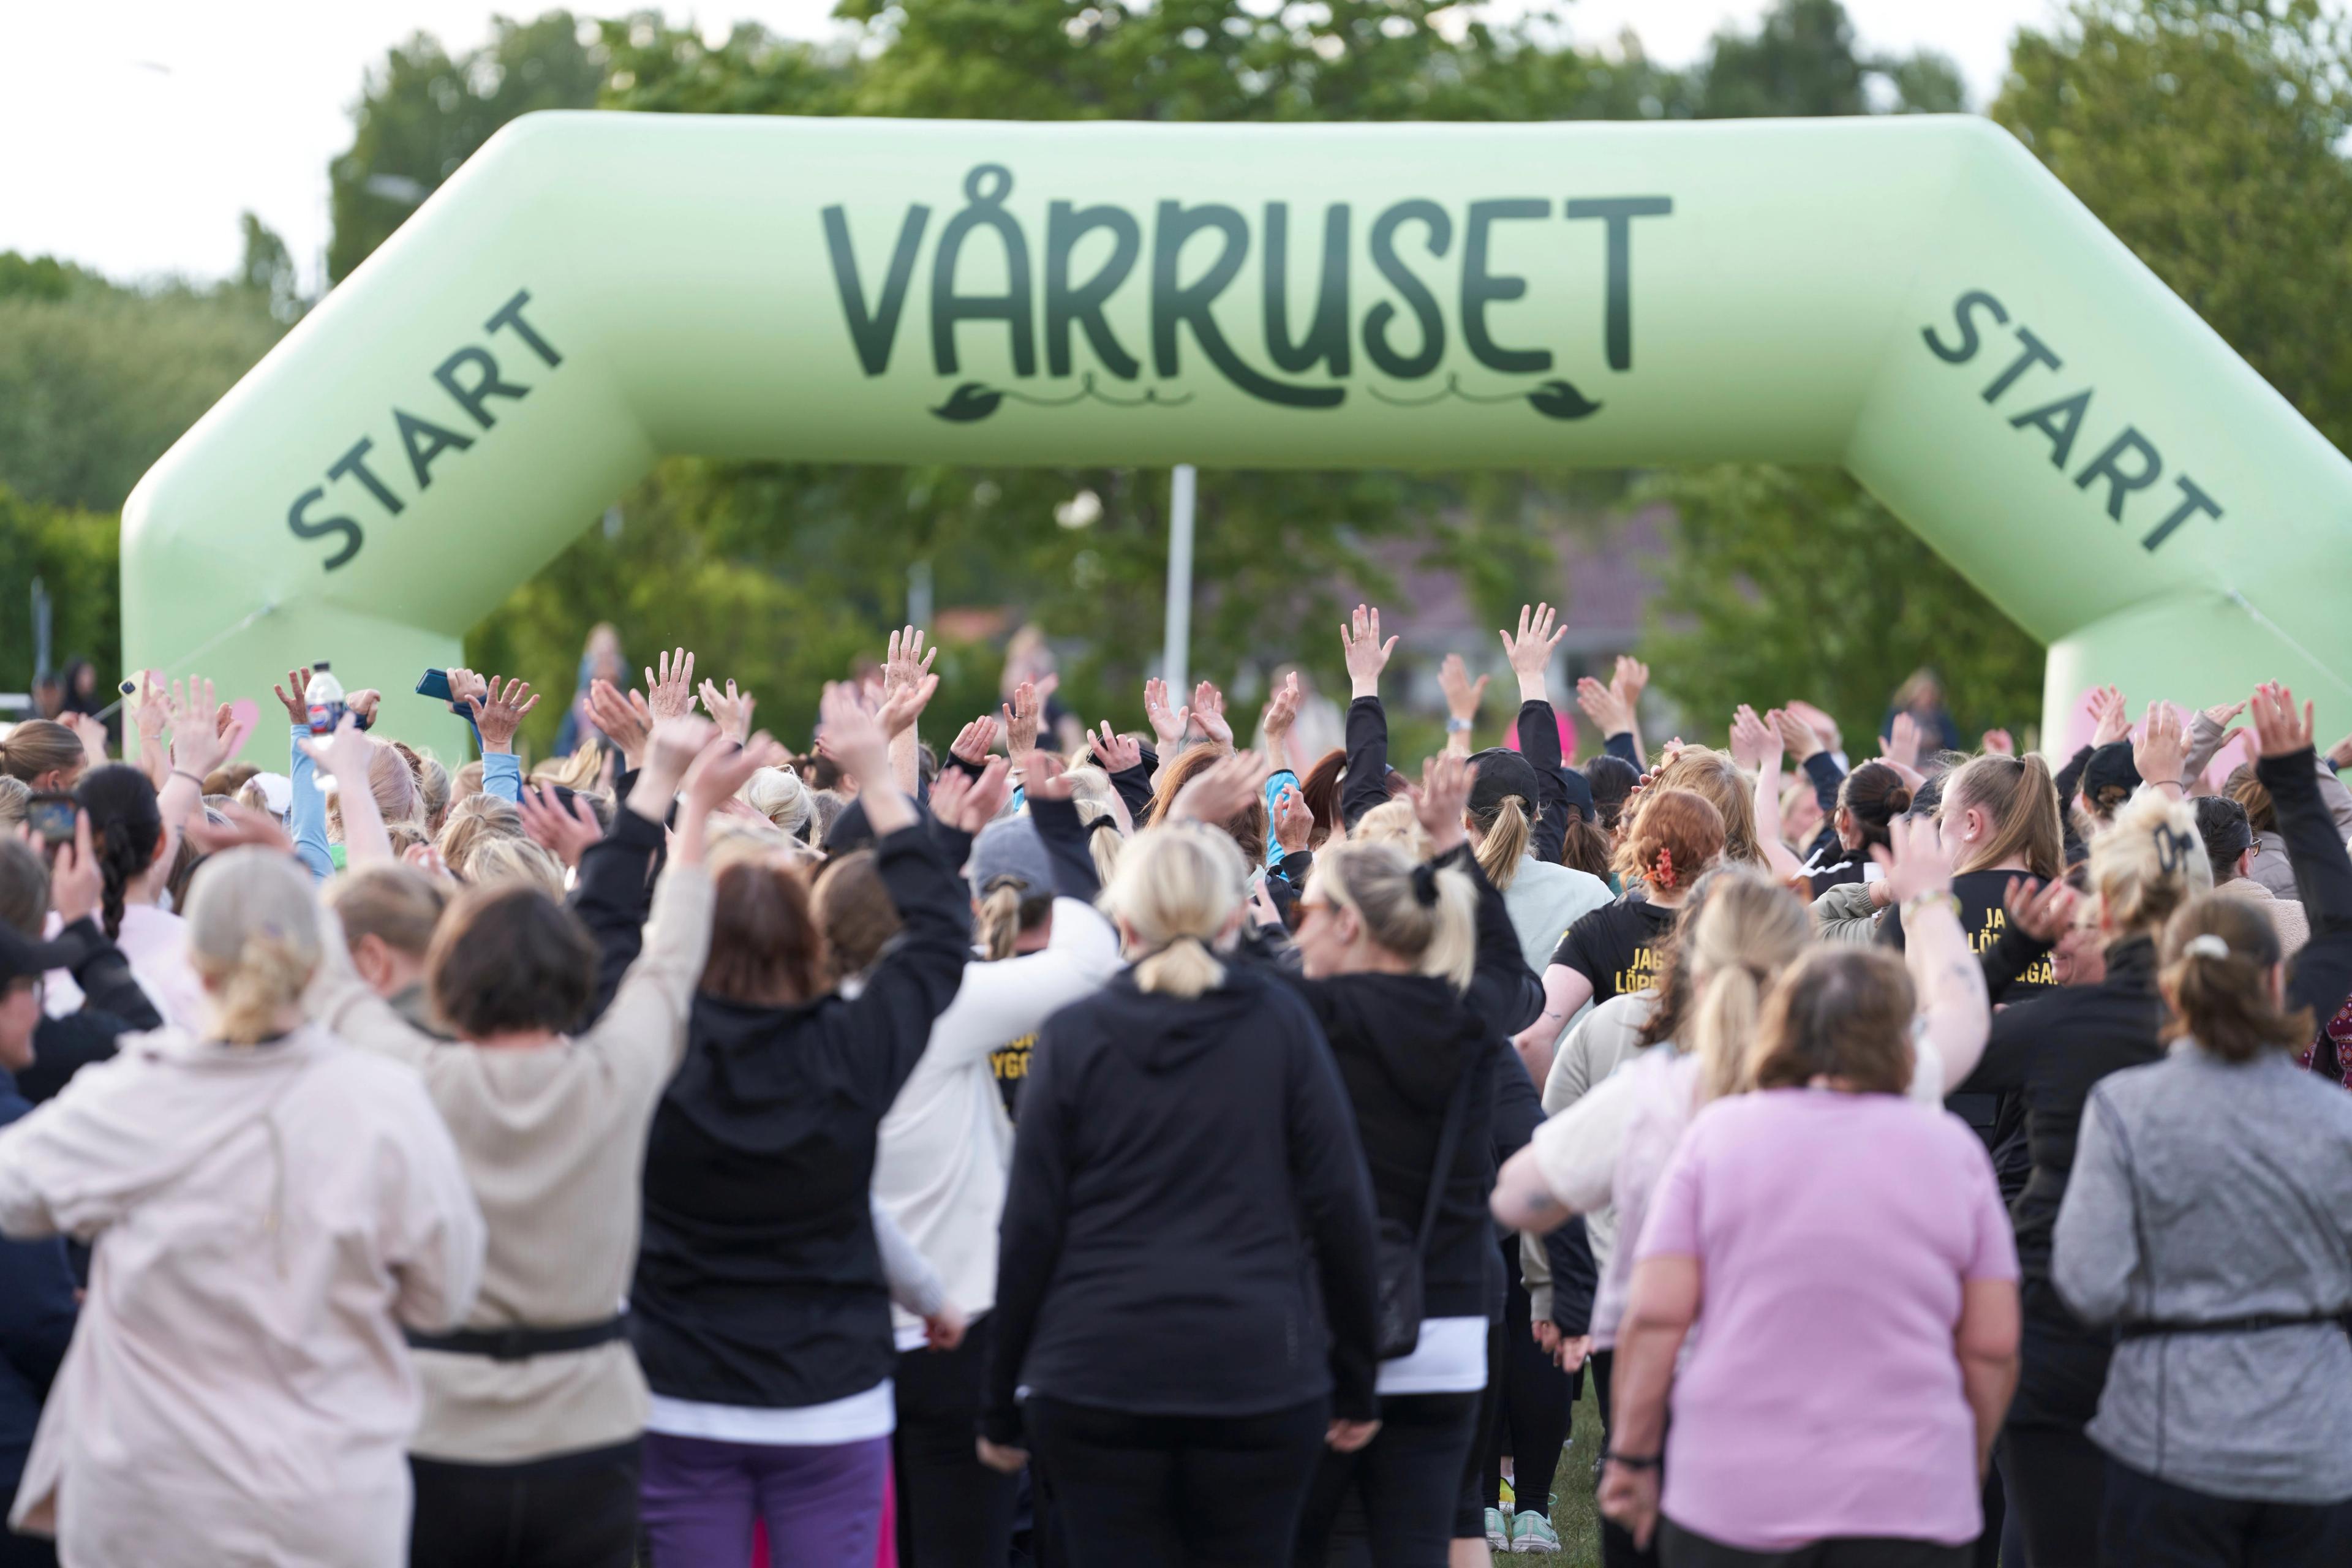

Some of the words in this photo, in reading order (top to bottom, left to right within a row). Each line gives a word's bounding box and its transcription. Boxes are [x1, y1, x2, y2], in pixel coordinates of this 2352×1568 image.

[821, 162, 1673, 413] VÅRRUSET
[287, 289, 564, 571] START
[1921, 289, 2223, 553] START
[1615, 968, 1662, 993] LÖPE
[1986, 908, 2007, 929] JA
